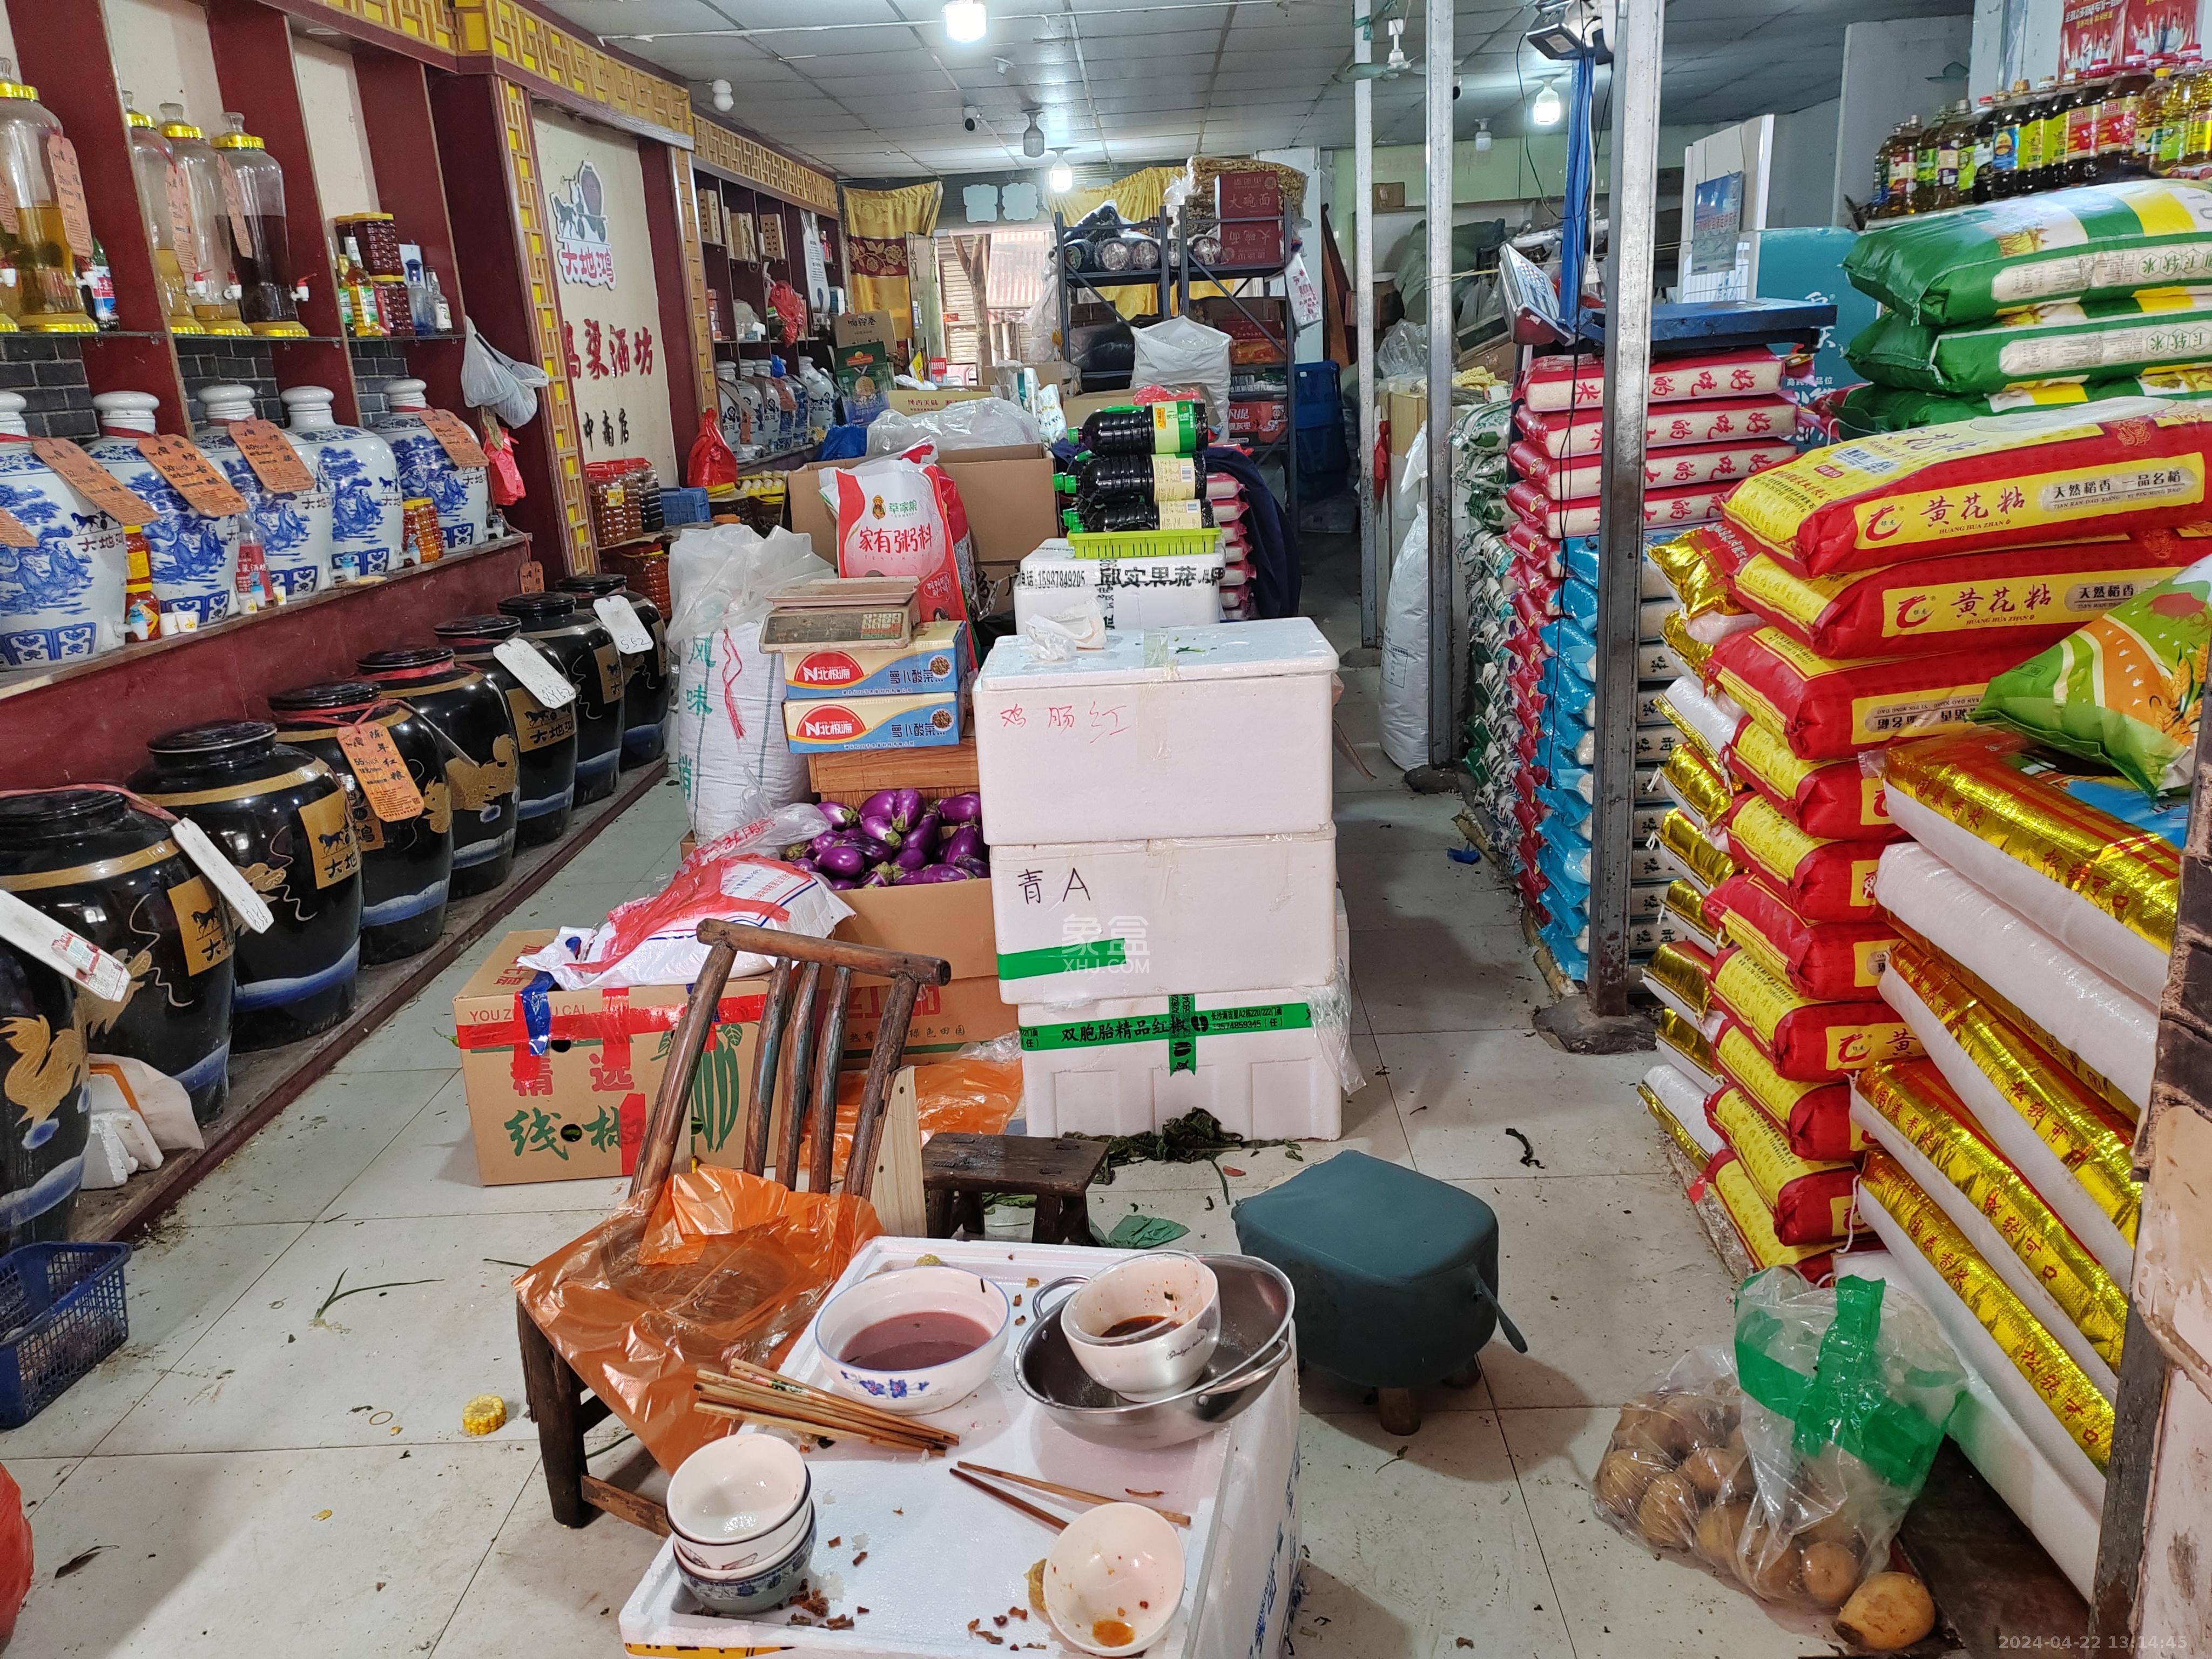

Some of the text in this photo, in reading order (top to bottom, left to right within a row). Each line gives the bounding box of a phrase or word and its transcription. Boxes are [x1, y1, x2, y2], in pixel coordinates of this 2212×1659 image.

[2054, 470, 2181, 499] 天然稻香 一品名稻
[1920, 487, 2025, 528] 黄花粘
[859, 522, 933, 554] 家有粥料
[1939, 520, 2005, 535] HUANG HUA ZHAN
[1950, 583, 2052, 619] 黄花粘
[2079, 584, 2134, 599] 天然稻香
[1966, 614, 2029, 625] HUANG HUA ZHAN
[687, 637, 716, 716] 风味
[1019, 868, 1090, 905] 青 A
[470, 1009, 500, 1022] YOU
[1060, 1015, 1189, 1043] 双胞胎精品红椒
